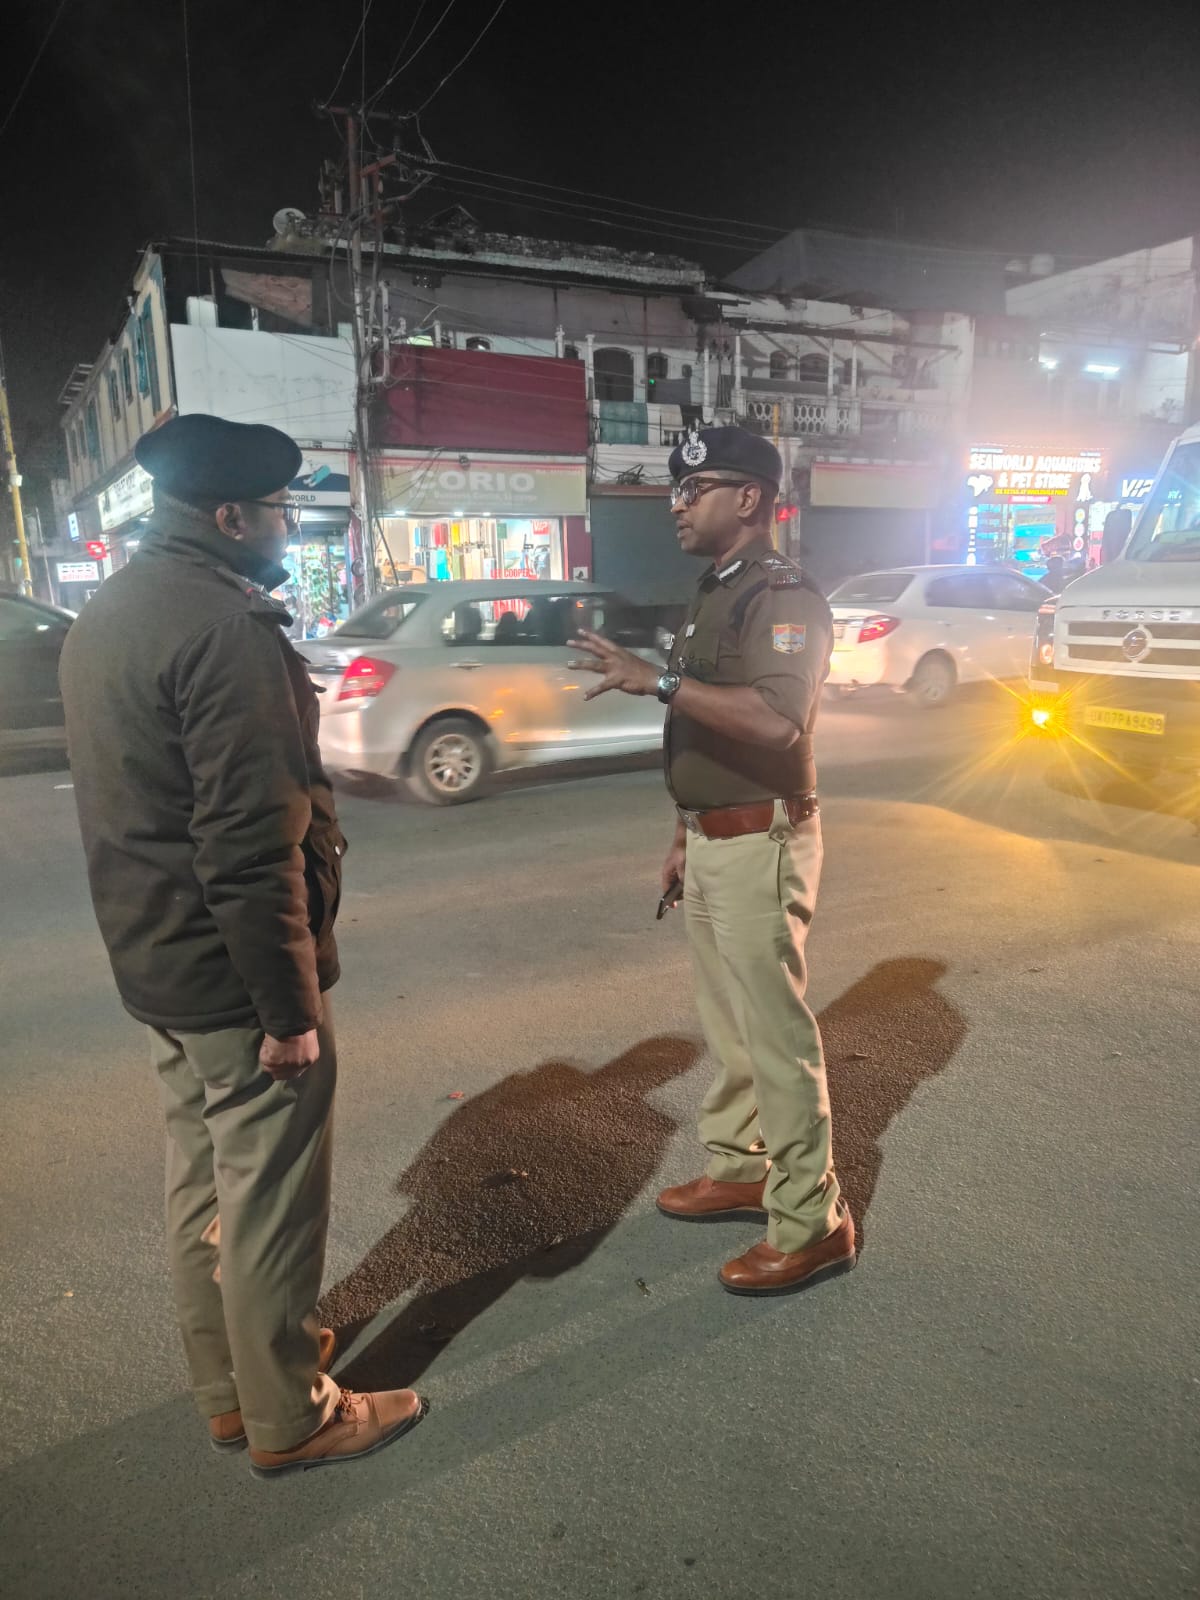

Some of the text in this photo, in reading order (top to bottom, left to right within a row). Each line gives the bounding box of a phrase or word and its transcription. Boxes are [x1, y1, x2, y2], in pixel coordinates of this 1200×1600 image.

[970, 454, 1034, 471] SEAWORLD
[998, 472, 1071, 488] & PET STORE
[1121, 479, 1154, 497] VIP
[1103, 609, 1182, 621] FORCE
